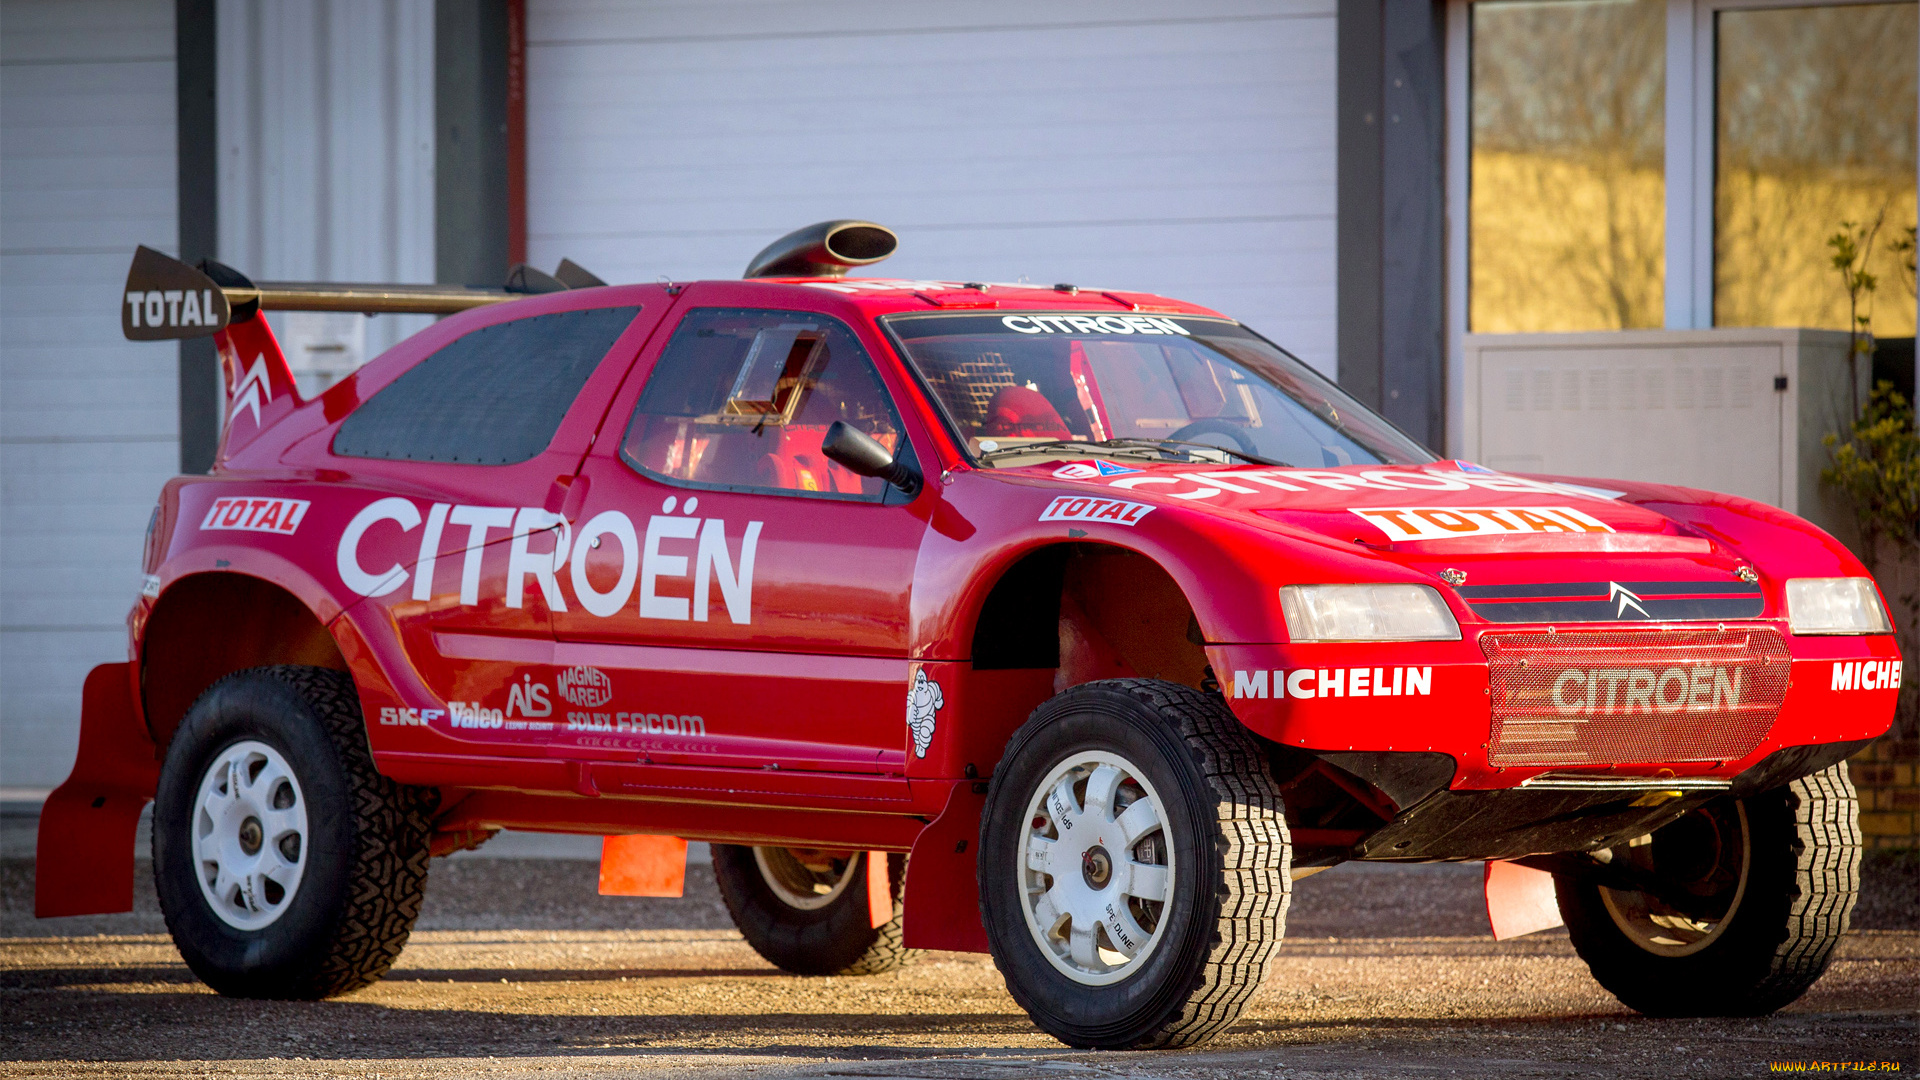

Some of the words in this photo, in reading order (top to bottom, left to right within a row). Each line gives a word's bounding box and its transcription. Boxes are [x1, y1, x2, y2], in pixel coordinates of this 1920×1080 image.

[126, 288, 219, 328] TOTAL
[1001, 315, 1191, 336] CITROEN
[208, 499, 300, 531] TOTAL
[1048, 498, 1144, 523] TOTAL
[1366, 509, 1612, 536] TOTAL
[336, 495, 764, 625] CITROËN
[1234, 666, 1432, 699] MICHELIN
[1551, 661, 1743, 714] CITROËN
[1831, 660, 1903, 691] MICHE
[380, 707, 445, 726] SKF
[448, 701, 503, 729] Valeo
[567, 711, 612, 732] SOLEX
[615, 712, 706, 737] FACOM
[1105, 903, 1135, 950] SPEDLINE
